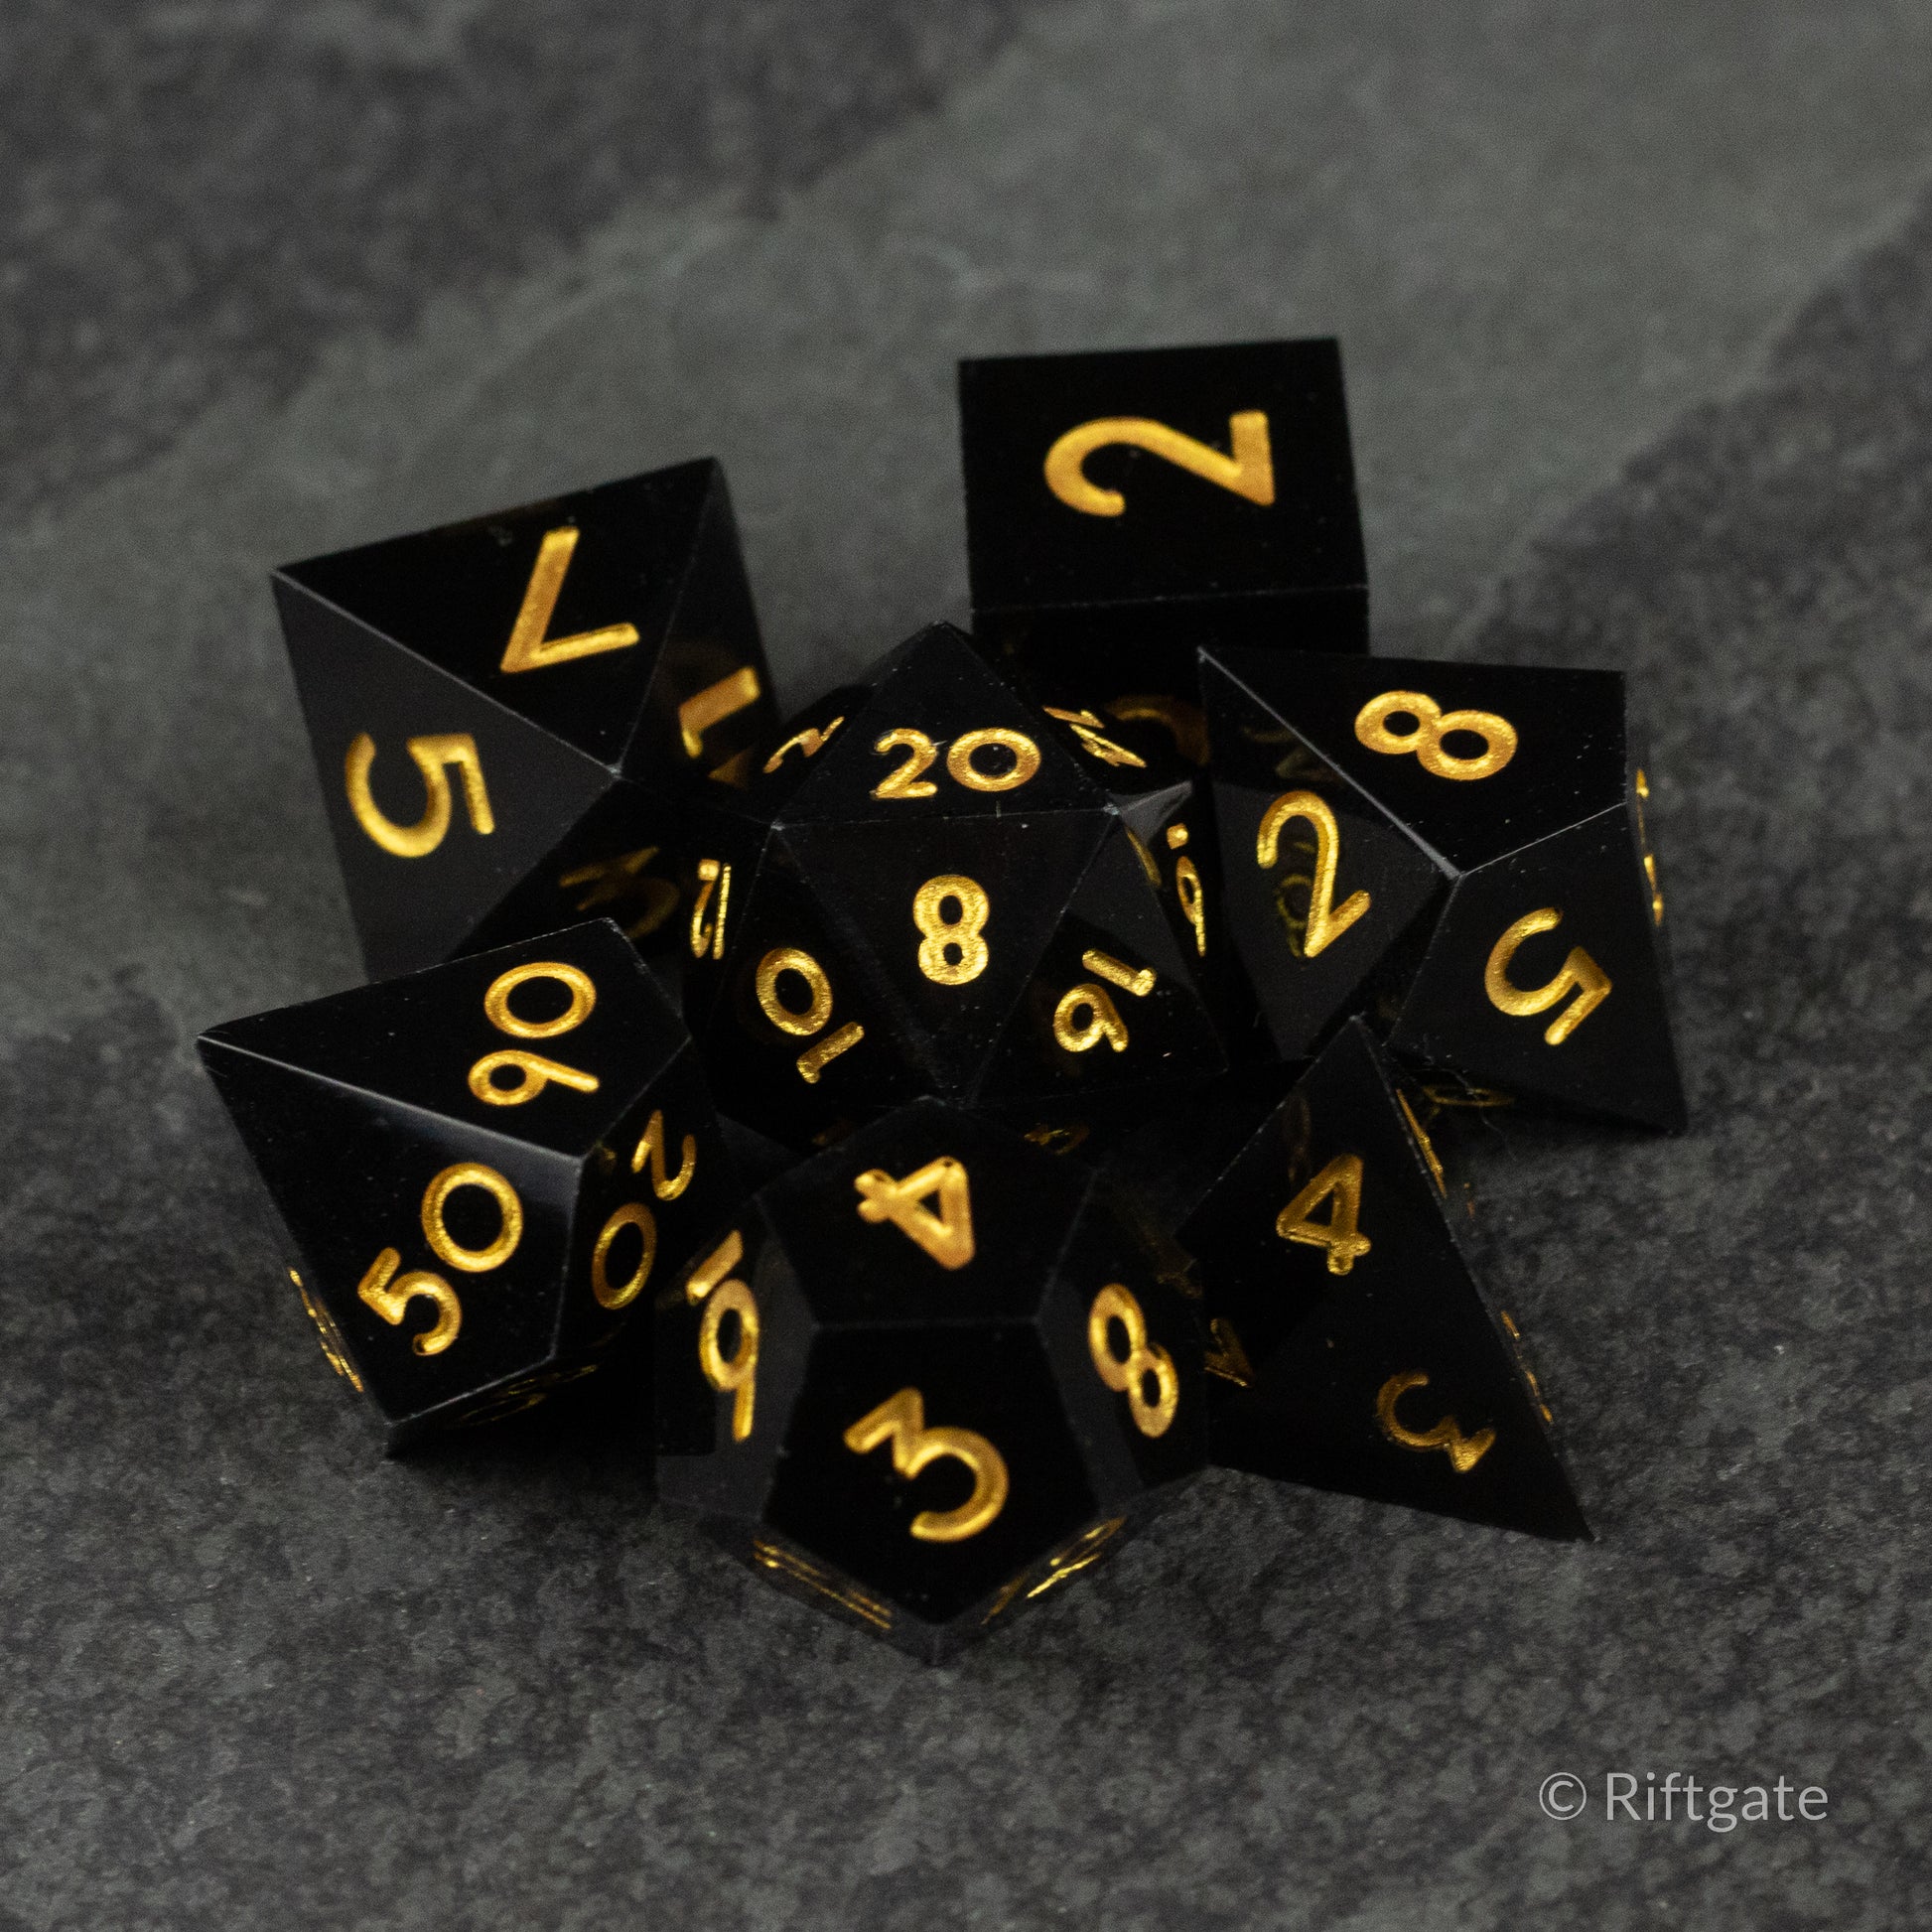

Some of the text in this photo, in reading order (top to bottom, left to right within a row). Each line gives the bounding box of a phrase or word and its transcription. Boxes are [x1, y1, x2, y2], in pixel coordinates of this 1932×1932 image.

[1043, 409, 1277, 518] 2
[499, 525, 641, 675] 7
[344, 731, 495, 860] 5
[869, 727, 1042, 799] 20
[1353, 689, 1520, 782] 8
[911, 874, 991, 987] 8
[1255, 790, 1374, 960] 2
[755, 946, 866, 1084] 10
[1052, 948, 1159, 1054] 16
[1483, 906, 1614, 1047] 5
[356, 1161, 526, 1358] 50
[591, 1108, 698, 1311] 20
[852, 1155, 977, 1272] 4
[1275, 1153, 1373, 1277] 4
[1086, 1282, 1180, 1440] 8
[1374, 1367, 1499, 1475] 3
[842, 1385, 1011, 1544] 3
